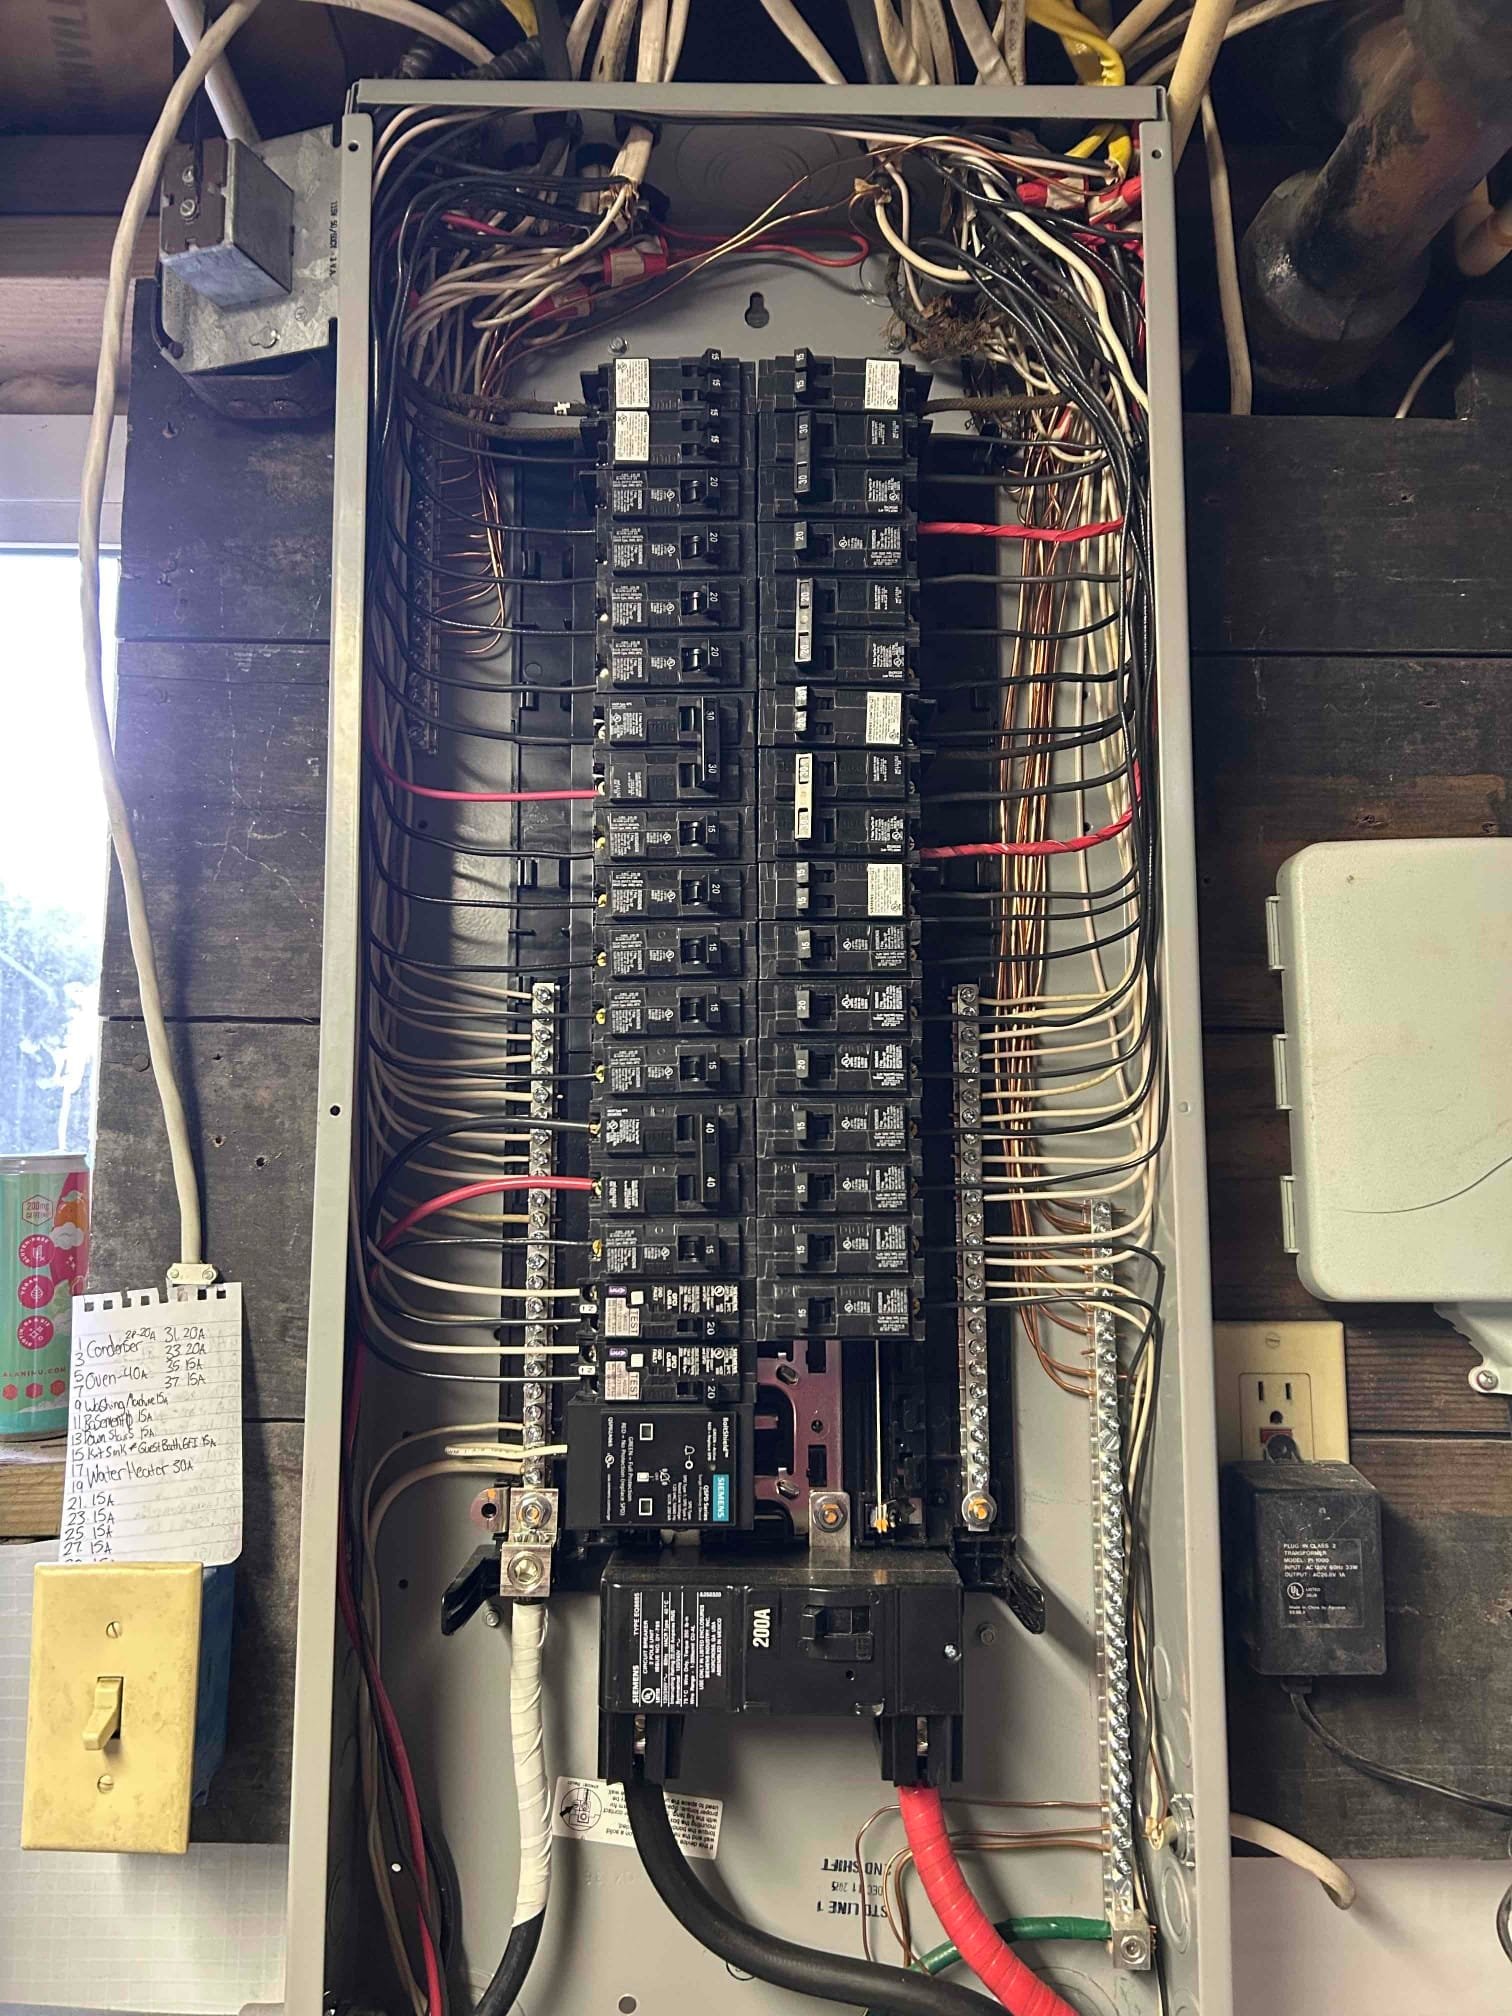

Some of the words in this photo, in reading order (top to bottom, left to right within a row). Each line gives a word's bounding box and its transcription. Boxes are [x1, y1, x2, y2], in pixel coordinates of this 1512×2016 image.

[711, 353, 719, 361] 15
[797, 353, 805, 361] 15
[712, 379, 720, 387] 15
[797, 379, 805, 388] 15
[710, 408, 718, 417] 15
[800, 424, 808, 433] 30
[711, 435, 719, 443] 15
[710, 476, 718, 487] 20
[798, 474, 808, 484] 30
[709, 532, 718, 542] 20
[796, 531, 804, 541] 20
[710, 592, 718, 602] 20
[801, 591, 810, 601] 20
[711, 647, 719, 657] 20
[800, 647, 810, 658] 20
[706, 710, 715, 721] 30
[708, 763, 717, 774] 30
[798, 868, 806, 876] 15
[712, 884, 720, 894] 20
[798, 896, 806, 904] 15
[709, 943, 717, 952] 15
[801, 941, 810, 950] 15
[710, 1004, 719, 1012] 15
[798, 1000, 806, 1011] 20
[708, 1061, 717, 1070] 15
[798, 1059, 806, 1069] 20
[705, 1122, 715, 1133] 40
[797, 1121, 805, 1130] 15
[707, 1177, 715, 1187] 40
[797, 1184, 805, 1193] 15
[706, 1245, 714, 1254] 15
[797, 1245, 805, 1254] 15
[798, 1308, 806, 1317] 15
[630, 1310, 638, 1334] TEST
[707, 1321, 715, 1335] 20
[86, 1334, 144, 1359] Condenser
[183, 1326, 208, 1339] 20A
[185, 1343, 207, 1355] 20A
[75, 1352, 86, 1367] 3
[73, 1369, 85, 1383] 5
[164, 1375, 179, 1389] 37
[186, 1372, 207, 1387] 15A
[73, 1385, 85, 1398] 7
[630, 1374, 638, 1398] TEST
[707, 1385, 715, 1399] 20
[156, 1392, 169, 1405] 15A
[73, 1415, 81, 1430] 11
[138, 1408, 153, 1423] 15A
[71, 1432, 82, 1446] 13
[140, 1425, 155, 1440] 15A
[71, 1448, 85, 1463] 15
[71, 1463, 84, 1478] 17
[86, 1463, 127, 1489] Water
[126, 1460, 170, 1481] Heater
[72, 1479, 84, 1494] 19
[92, 1491, 115, 1507] 15A
[717, 1477, 726, 1519] SIEMENS
[93, 1507, 115, 1524] 15A
[64, 1527, 84, 1542] 25
[92, 1523, 113, 1539] 15A
[90, 1540, 113, 1555] 15A
[753, 1608, 771, 1648] 200A
[632, 1665, 640, 1704] SIEMENS
[820, 1858, 859, 1873] SHIFT
[867, 1884, 884, 1897] DEC
[816, 1900, 824, 1912] 1
[828, 1900, 859, 1916] LINE
